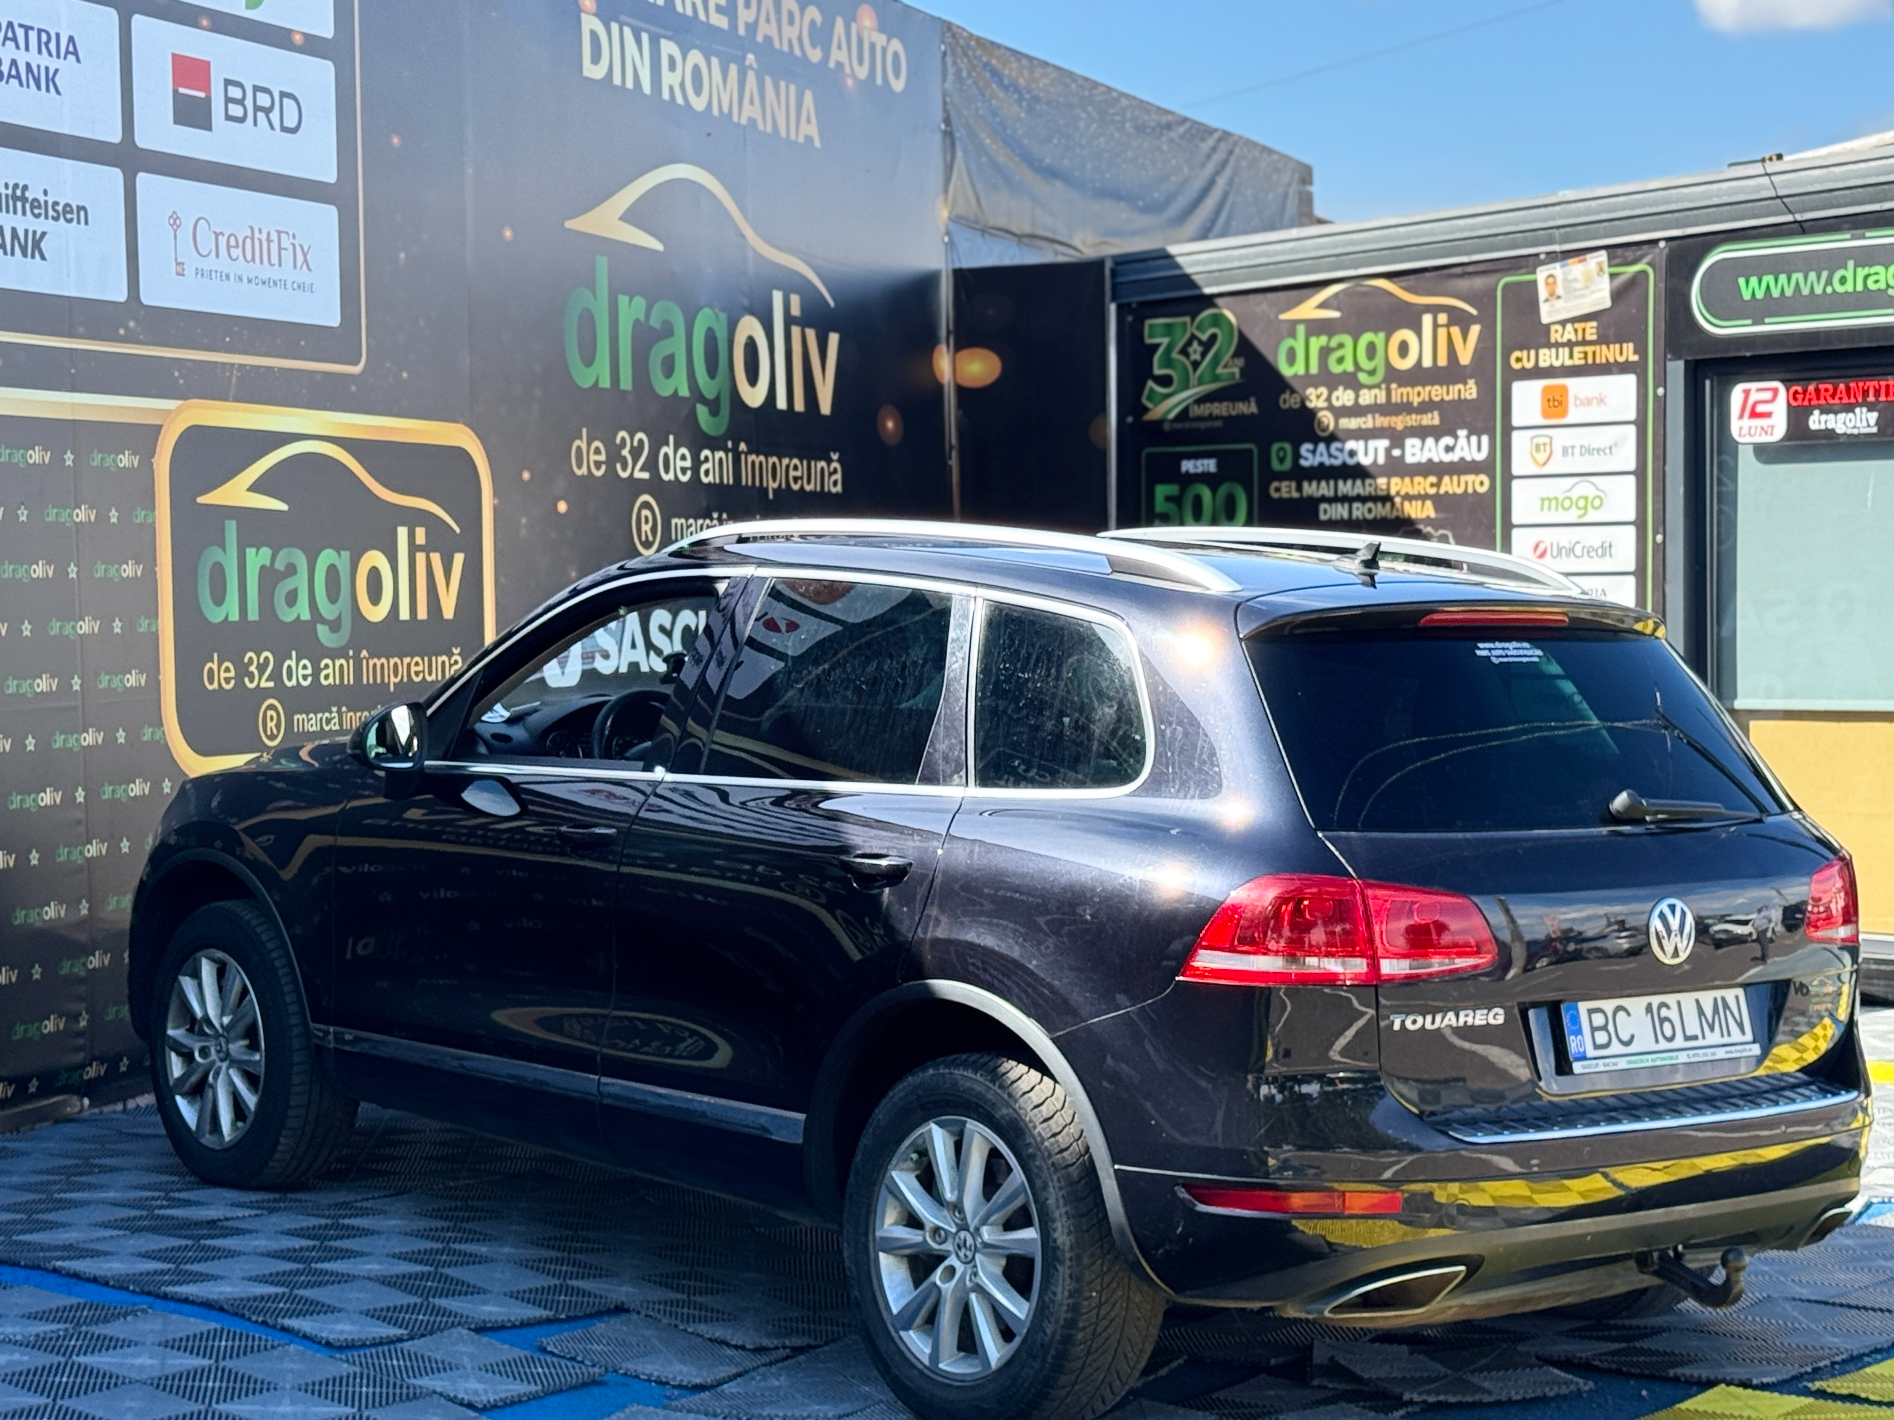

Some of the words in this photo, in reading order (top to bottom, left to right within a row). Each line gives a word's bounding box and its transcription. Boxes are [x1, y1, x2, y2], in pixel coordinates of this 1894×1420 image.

[0, 20, 82, 65] ATRIA
[827, 15, 907, 93] AUTO
[580, 12, 651, 96] DIN
[660, 38, 821, 149] ROMÂNIA
[223, 77, 304, 136] BRD
[0, 181, 90, 227] iffeisen
[0, 224, 48, 262] ANK
[191, 216, 313, 273] CreditFix
[194, 266, 231, 283] PRIETEN
[246, 274, 289, 291] MOMENTE
[290, 280, 316, 294] CHEIE
[563, 255, 840, 437] dragoliv
[1549, 321, 1598, 345] RATE
[1276, 312, 1482, 386] dragoliv
[1509, 349, 1537, 370] CU
[1537, 343, 1640, 368] BULETINUL
[1278, 391, 1300, 410] de
[1304, 386, 1329, 409] 32
[1331, 385, 1356, 408] de
[1357, 383, 1387, 406] ani
[1389, 378, 1478, 408] împreună
[1546, 393, 1564, 409] tbi
[1572, 392, 1608, 409] bank
[1737, 386, 1780, 421] 12
[1737, 424, 1776, 439] LUNI
[1807, 406, 1879, 435] dragoliv
[89, 448, 140, 471] dragoliv
[1298, 438, 1390, 468] SASCUT
[1404, 428, 1490, 465] BACĂU
[1534, 442, 1549, 455] BT
[1561, 444, 1577, 458] BT
[571, 428, 606, 477] de
[615, 430, 650, 479] 32
[658, 434, 692, 483] de
[699, 440, 734, 486] ani
[740, 441, 843, 500] împreună
[1180, 458, 1218, 475] PESTE
[1269, 480, 1300, 499] CEL
[1301, 478, 1335, 498] MAI
[1336, 476, 1389, 497] MARE
[1389, 474, 1438, 497] PARC
[1438, 472, 1491, 496] AUTO
[44, 503, 97, 527] dragoliv
[1152, 481, 1249, 528] 500
[1318, 501, 1350, 522] DIN
[1351, 496, 1437, 521] ROMÂNIA
[1539, 494, 1605, 520] mogo
[1549, 540, 1614, 560] UniCredit
[1, 560, 55, 583] dragoliv
[93, 559, 144, 582] dragoliv
[196, 519, 465, 648] dragoliv
[48, 616, 100, 639] dragoliv
[4, 673, 58, 698] dragoliv
[98, 668, 147, 692] dragoliv
[203, 653, 236, 691] de
[243, 651, 275, 689] 32
[282, 650, 313, 687] de
[319, 649, 354, 685] ani
[360, 646, 463, 693] împreună
[293, 706, 341, 733] marcă
[52, 727, 104, 752] dragoliv
[8, 786, 62, 812] dragoliv
[101, 778, 151, 801] dragoliv
[55, 838, 108, 864] dragoliv
[11, 900, 67, 926] dragoliv
[58, 949, 111, 976] dragoliv
[12, 1014, 66, 1041] dragoliv
[1389, 1007, 1505, 1031] TOUAREG
[1586, 1005, 1636, 1051] BC
[1644, 994, 1747, 1045] 16LMN
[1571, 1035, 1584, 1054] RO
